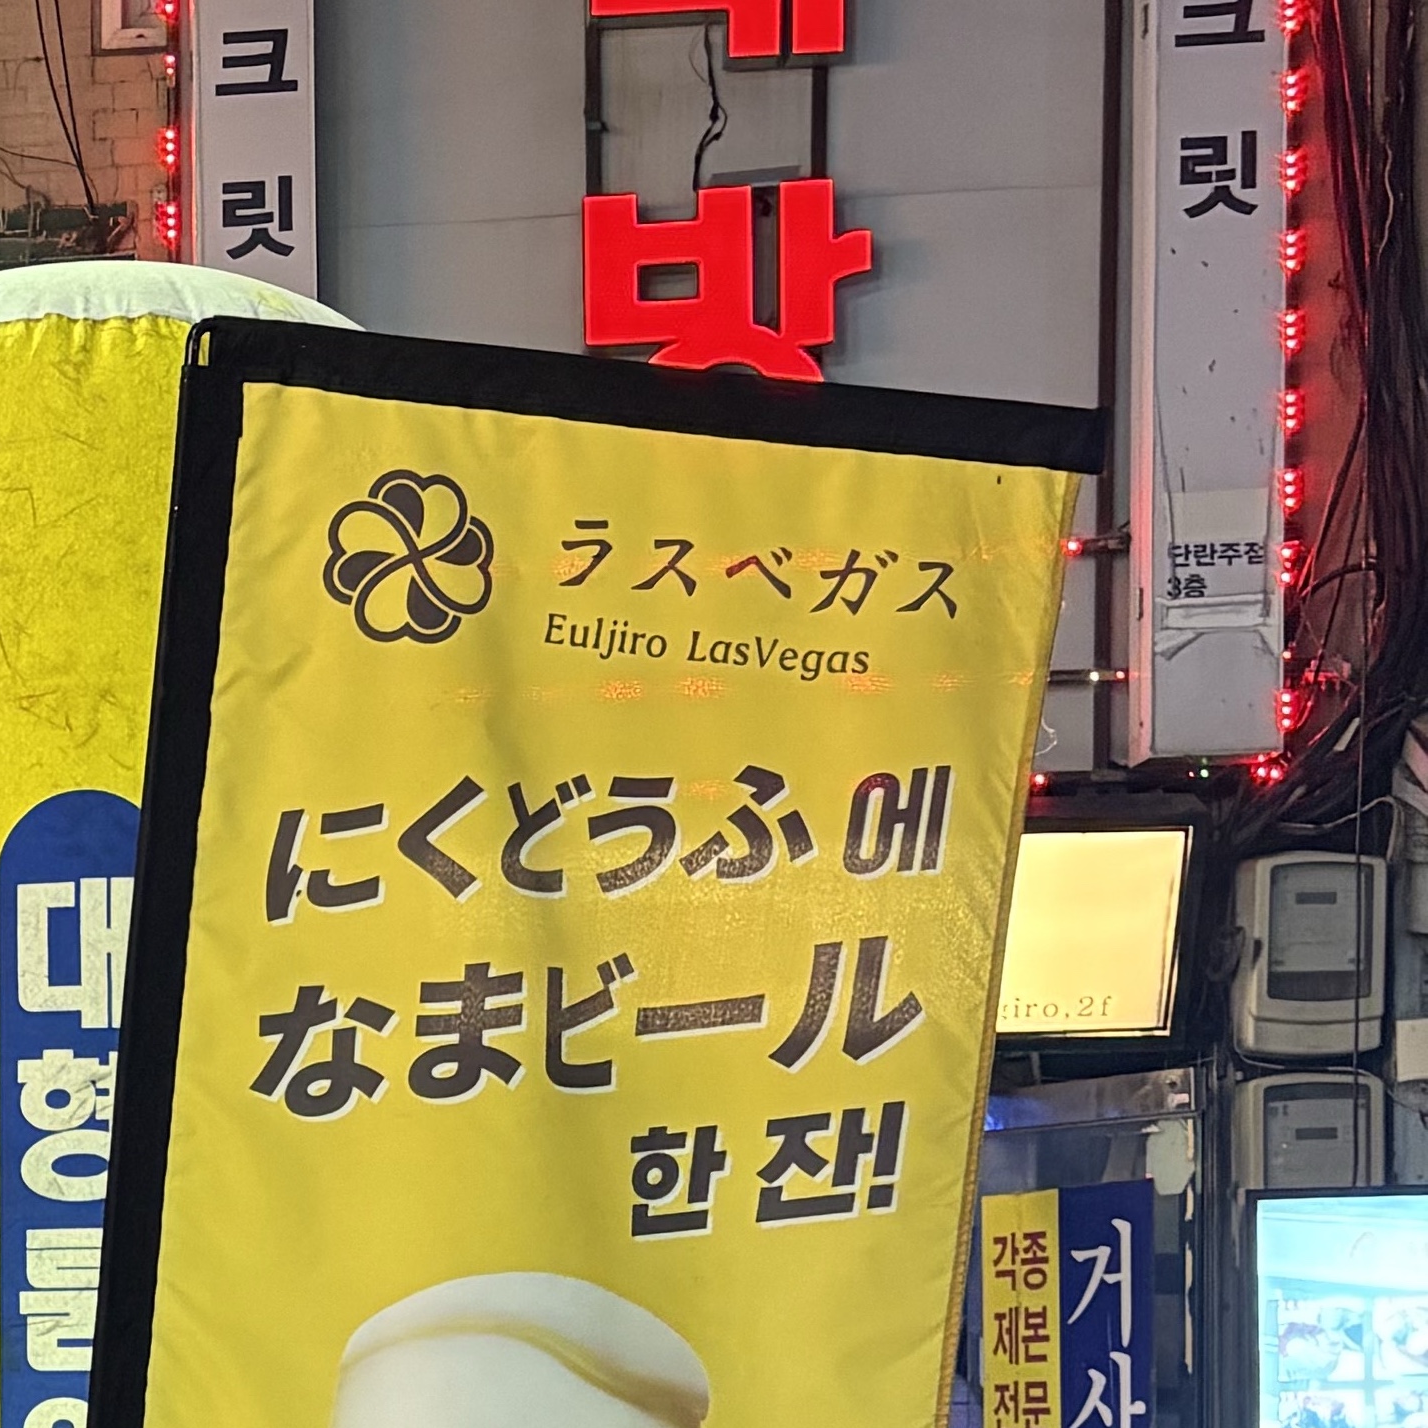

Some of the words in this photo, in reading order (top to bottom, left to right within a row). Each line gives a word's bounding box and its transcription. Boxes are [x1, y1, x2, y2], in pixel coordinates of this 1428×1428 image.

[558, 518, 960, 620] ラスベガス
[1167, 542, 1264, 567] 단란주점
[1167, 574, 1207, 599] 3층
[544, 614, 668, 661] Euljiro
[687, 630, 872, 683] LasVegas
[265, 764, 816, 926] にくどうふ
[842, 764, 954, 877] 에
[250, 936, 923, 1119] なまビール
[629, 1124, 728, 1241] 한
[756, 1100, 906, 1227] 잔!
[992, 1231, 1050, 1291] 각종
[992, 1305, 1051, 1366] 제본
